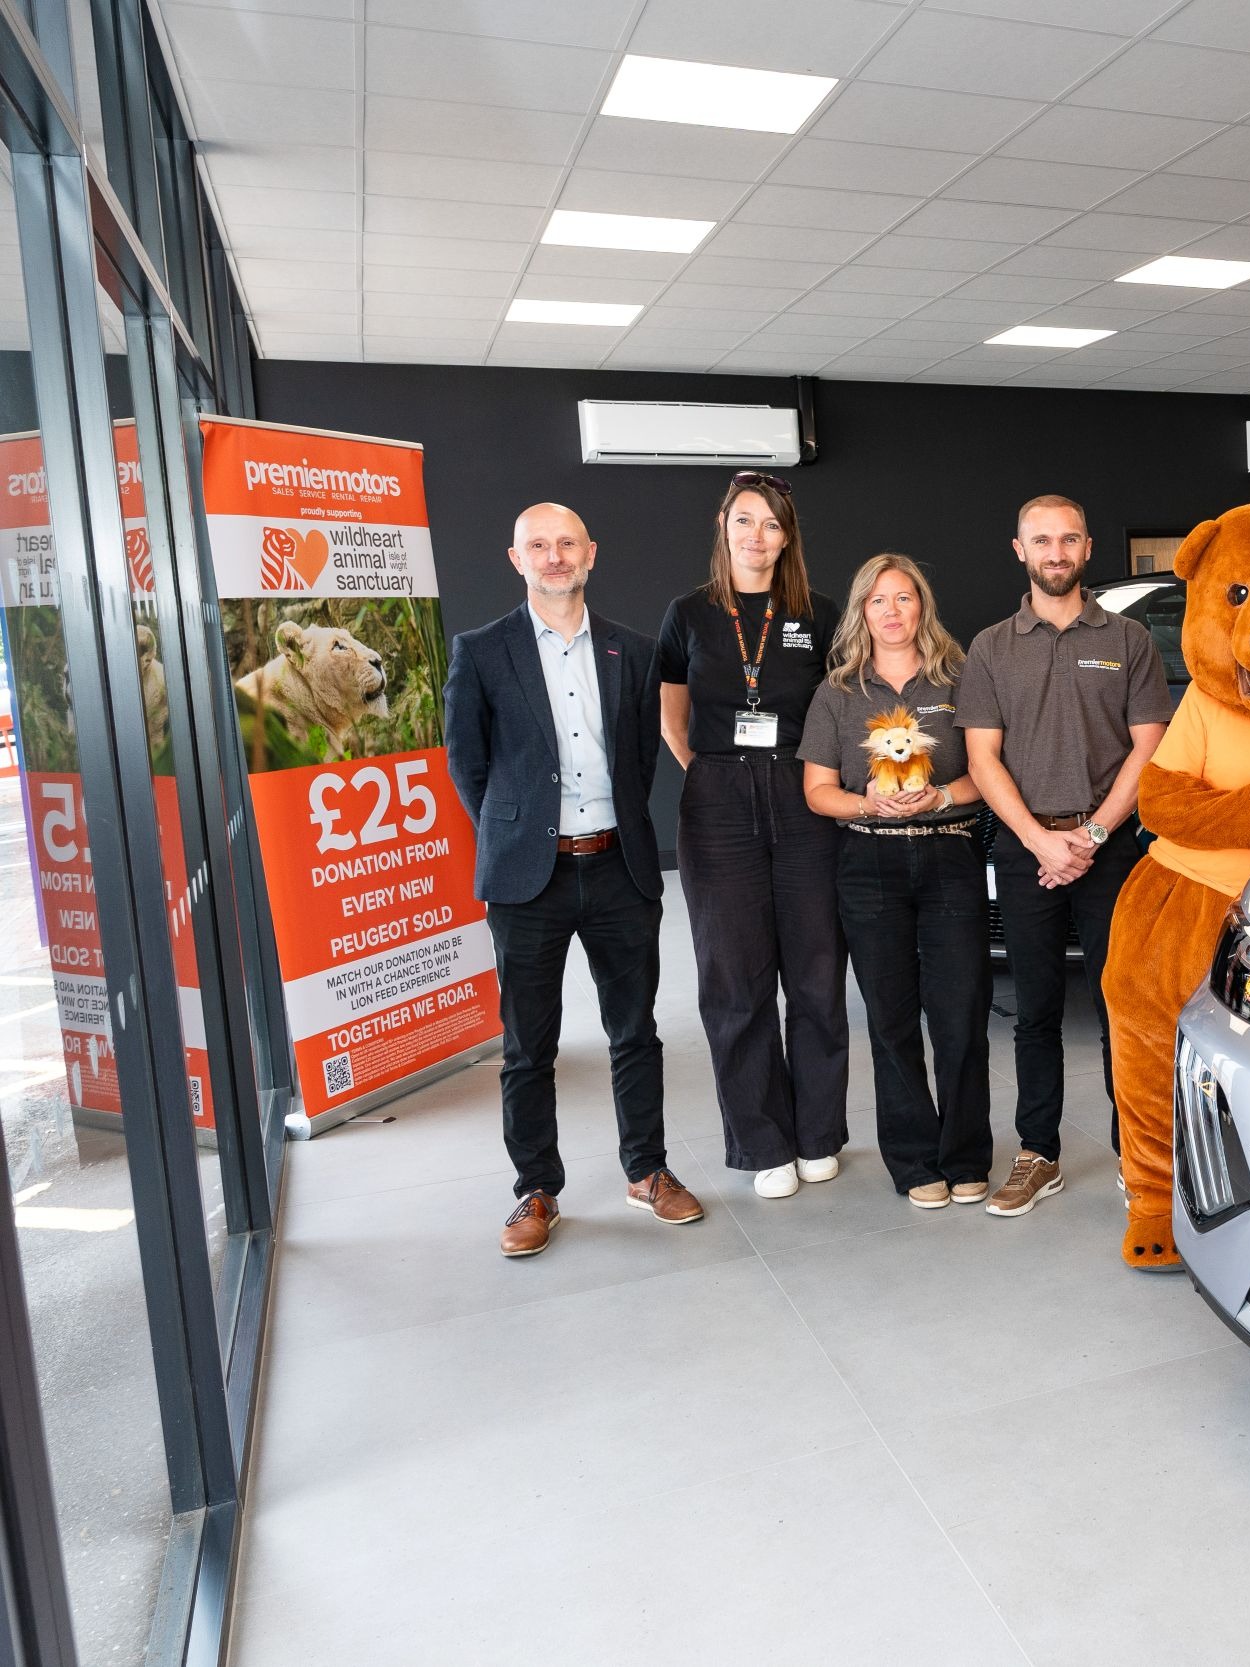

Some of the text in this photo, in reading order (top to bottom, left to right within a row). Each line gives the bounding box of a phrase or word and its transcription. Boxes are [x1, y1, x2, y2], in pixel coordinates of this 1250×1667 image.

[244, 458, 401, 497] premiermotors
[272, 487, 383, 504] SALES SERVICE RENTAL REPAIR
[300, 507, 363, 520] proudly supporting
[330, 526, 404, 549] wildheart
[333, 548, 387, 569] animal
[388, 551, 400, 561] isle
[336, 572, 413, 595] sanctuary
[390, 561, 407, 572] wight
[308, 758, 437, 855] £25
[311, 838, 449, 887] DONATION FROM
[341, 875, 434, 917] EVERY NEW
[331, 905, 453, 958] PEUGEOT SOLD
[326, 935, 463, 990] MATCH OUR DONATION AND BE
[336, 950, 459, 1001] IN WITH A CHANCE TO WIN A
[350, 967, 451, 1011] LION FEED EXPERIENCE
[327, 982, 478, 1051] TOGETHER WE ROAR.
